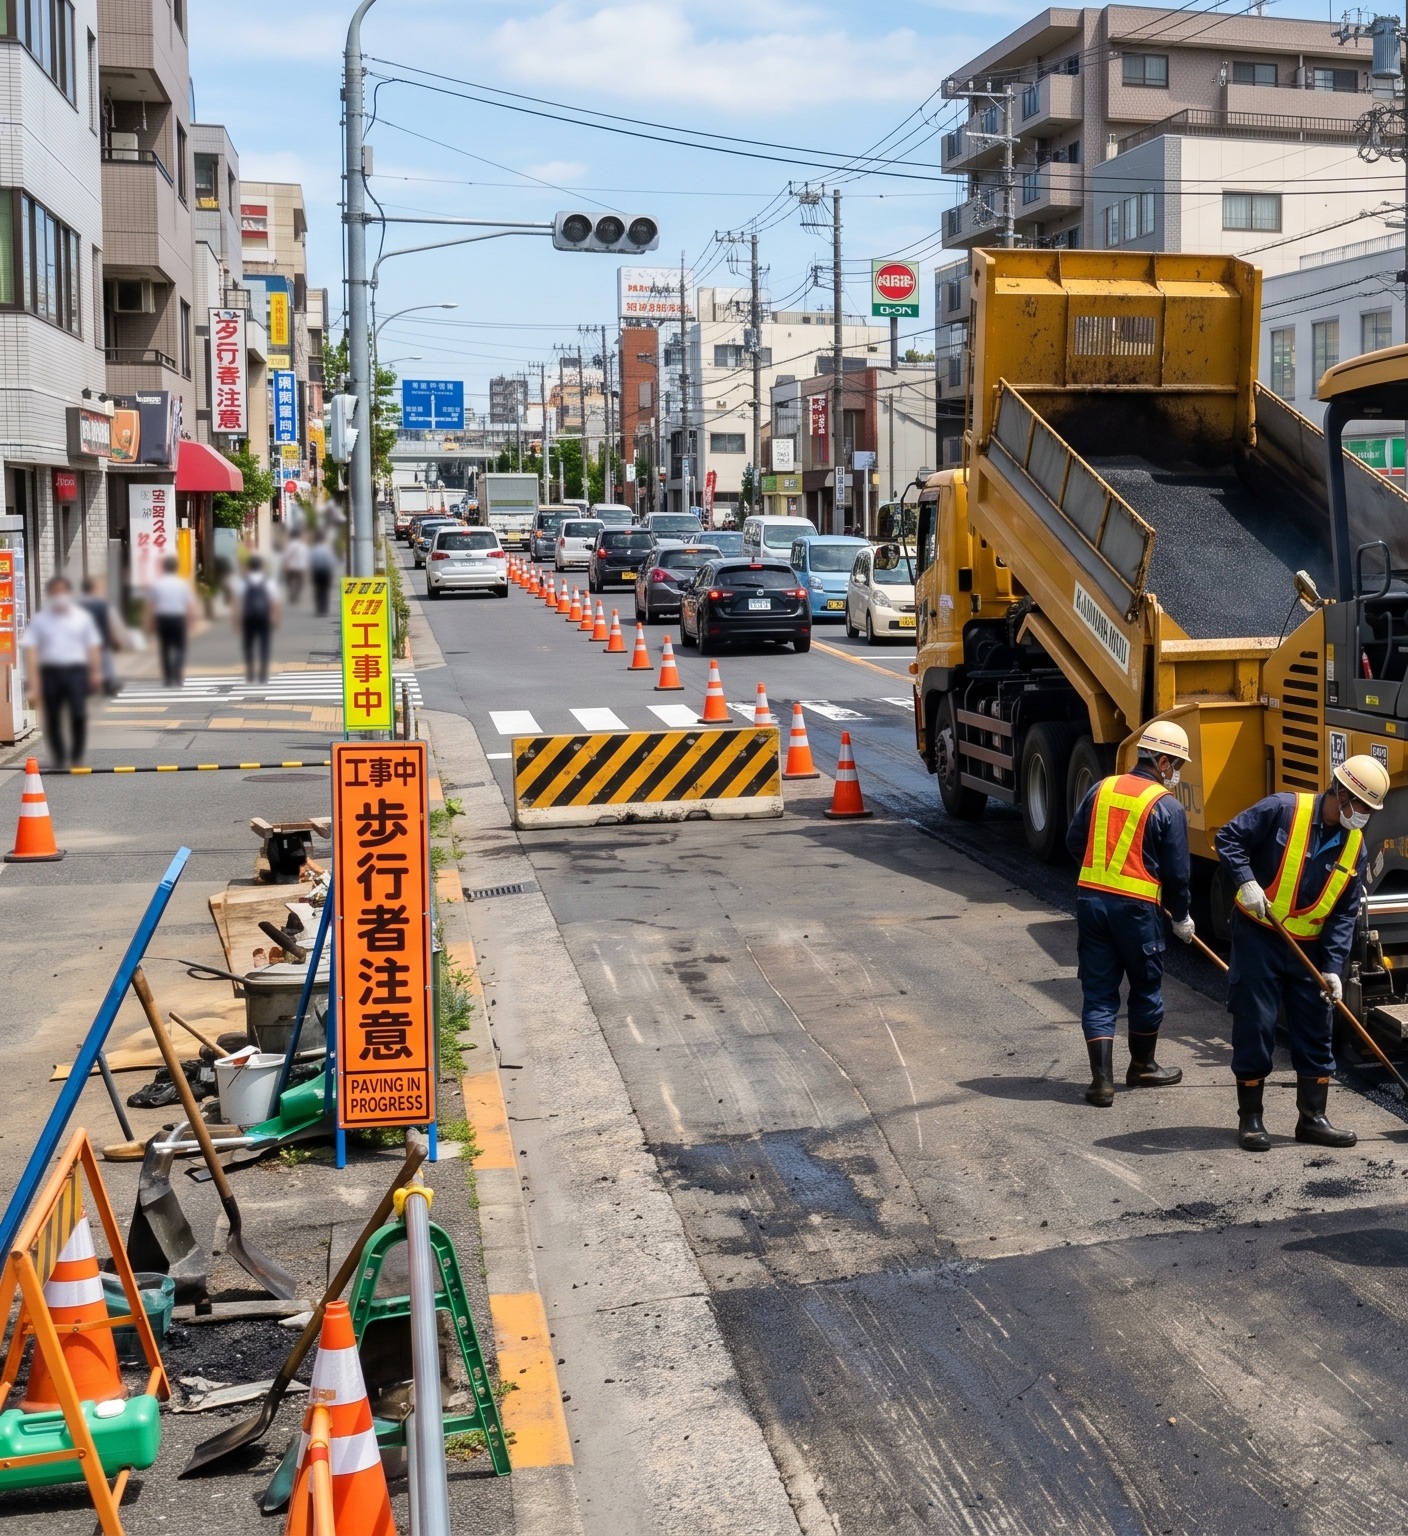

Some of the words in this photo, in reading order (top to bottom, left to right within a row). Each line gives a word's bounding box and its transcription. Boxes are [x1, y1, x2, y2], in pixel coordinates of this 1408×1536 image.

[351, 623, 382, 717] 工事中
[345, 756, 417, 788] 工事中
[355, 797, 413, 1061] 歩行者注意
[351, 1077, 404, 1094] PAVING
[407, 1076, 420, 1091] IN
[351, 1095, 423, 1114] PROGRESS
